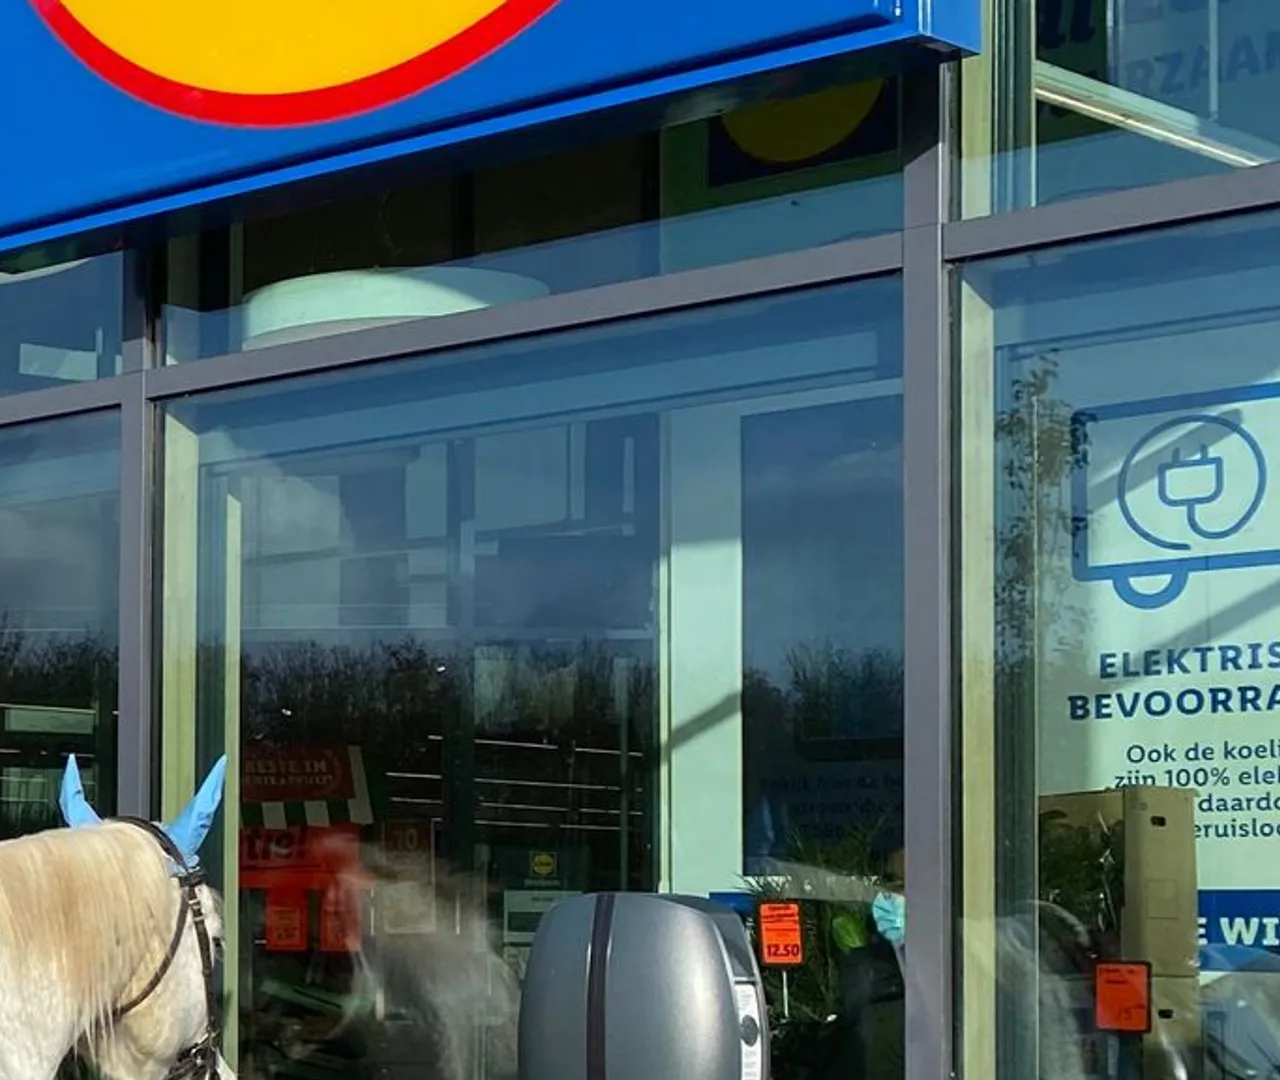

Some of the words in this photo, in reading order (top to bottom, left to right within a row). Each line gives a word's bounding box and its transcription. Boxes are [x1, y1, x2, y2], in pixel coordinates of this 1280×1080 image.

[1099, 641, 1280, 679] ELEKTRIS
[1126, 744, 1177, 764] Ook
[1184, 742, 1215, 761] de
[1224, 739, 1280, 760] koel
[1166, 767, 1230, 787] 100%
[1239, 765, 1280, 785] ele
